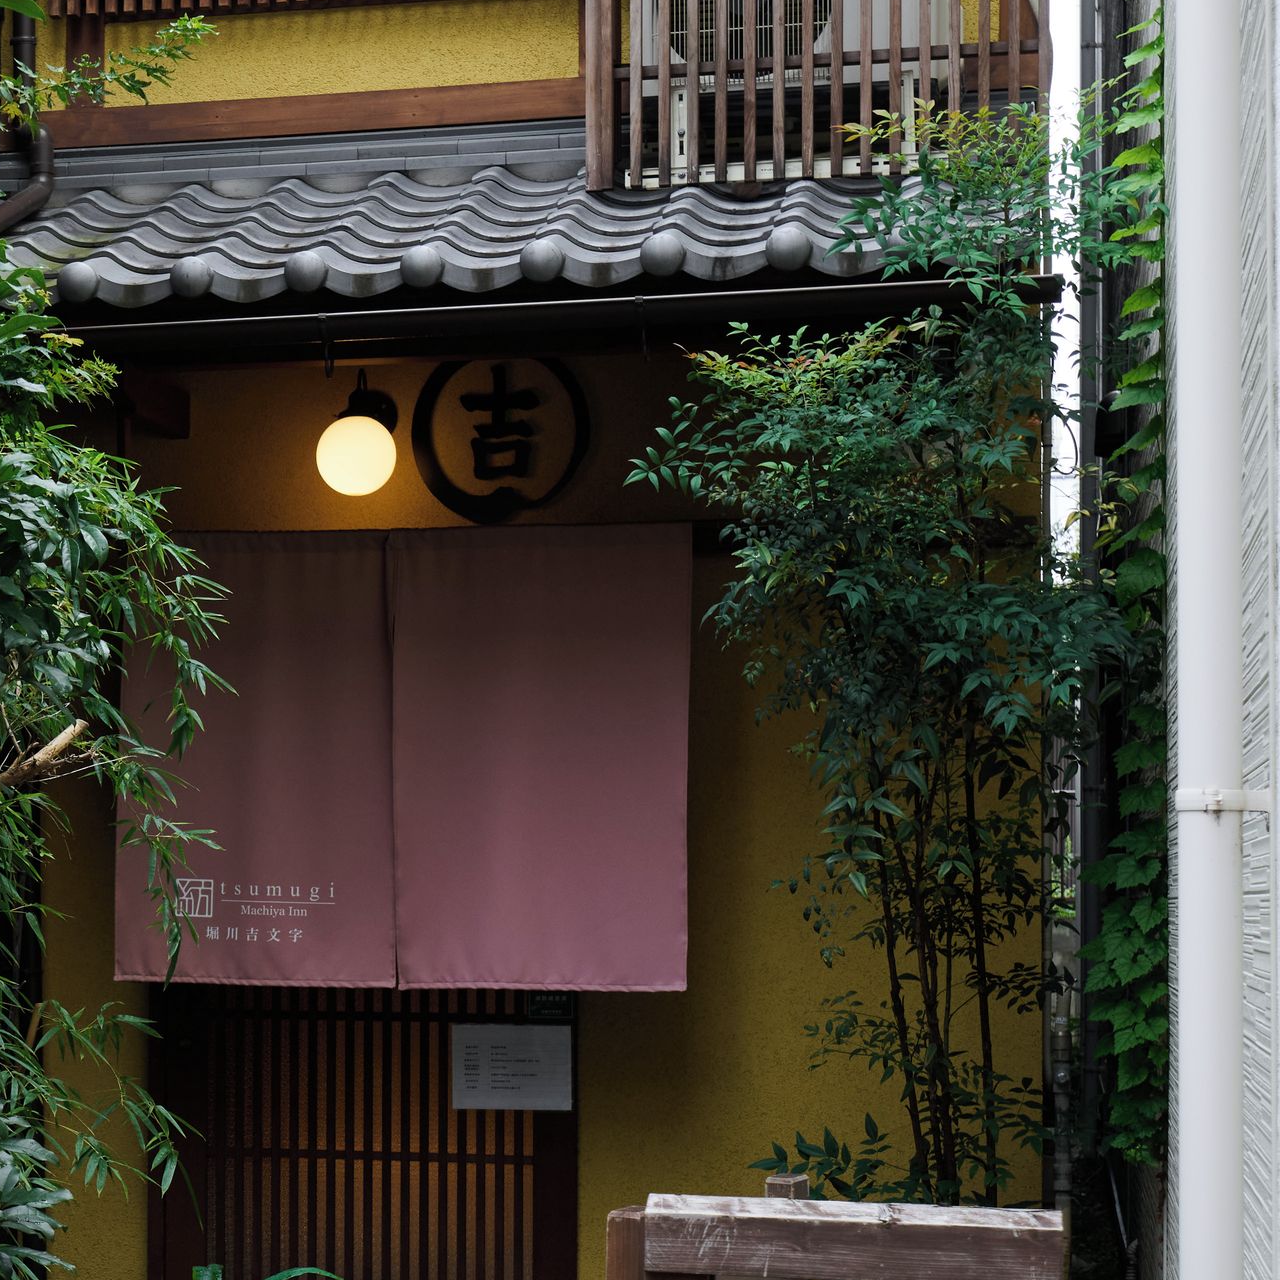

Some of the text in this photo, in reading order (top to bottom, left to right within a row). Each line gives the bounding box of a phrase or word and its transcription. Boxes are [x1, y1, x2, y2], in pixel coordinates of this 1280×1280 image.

[459, 363, 541, 481] 吉
[220, 882, 335, 902] tsumugi
[241, 904, 308, 917] Machiya Inn
[206, 926, 303, 943] 堀川吉文字
